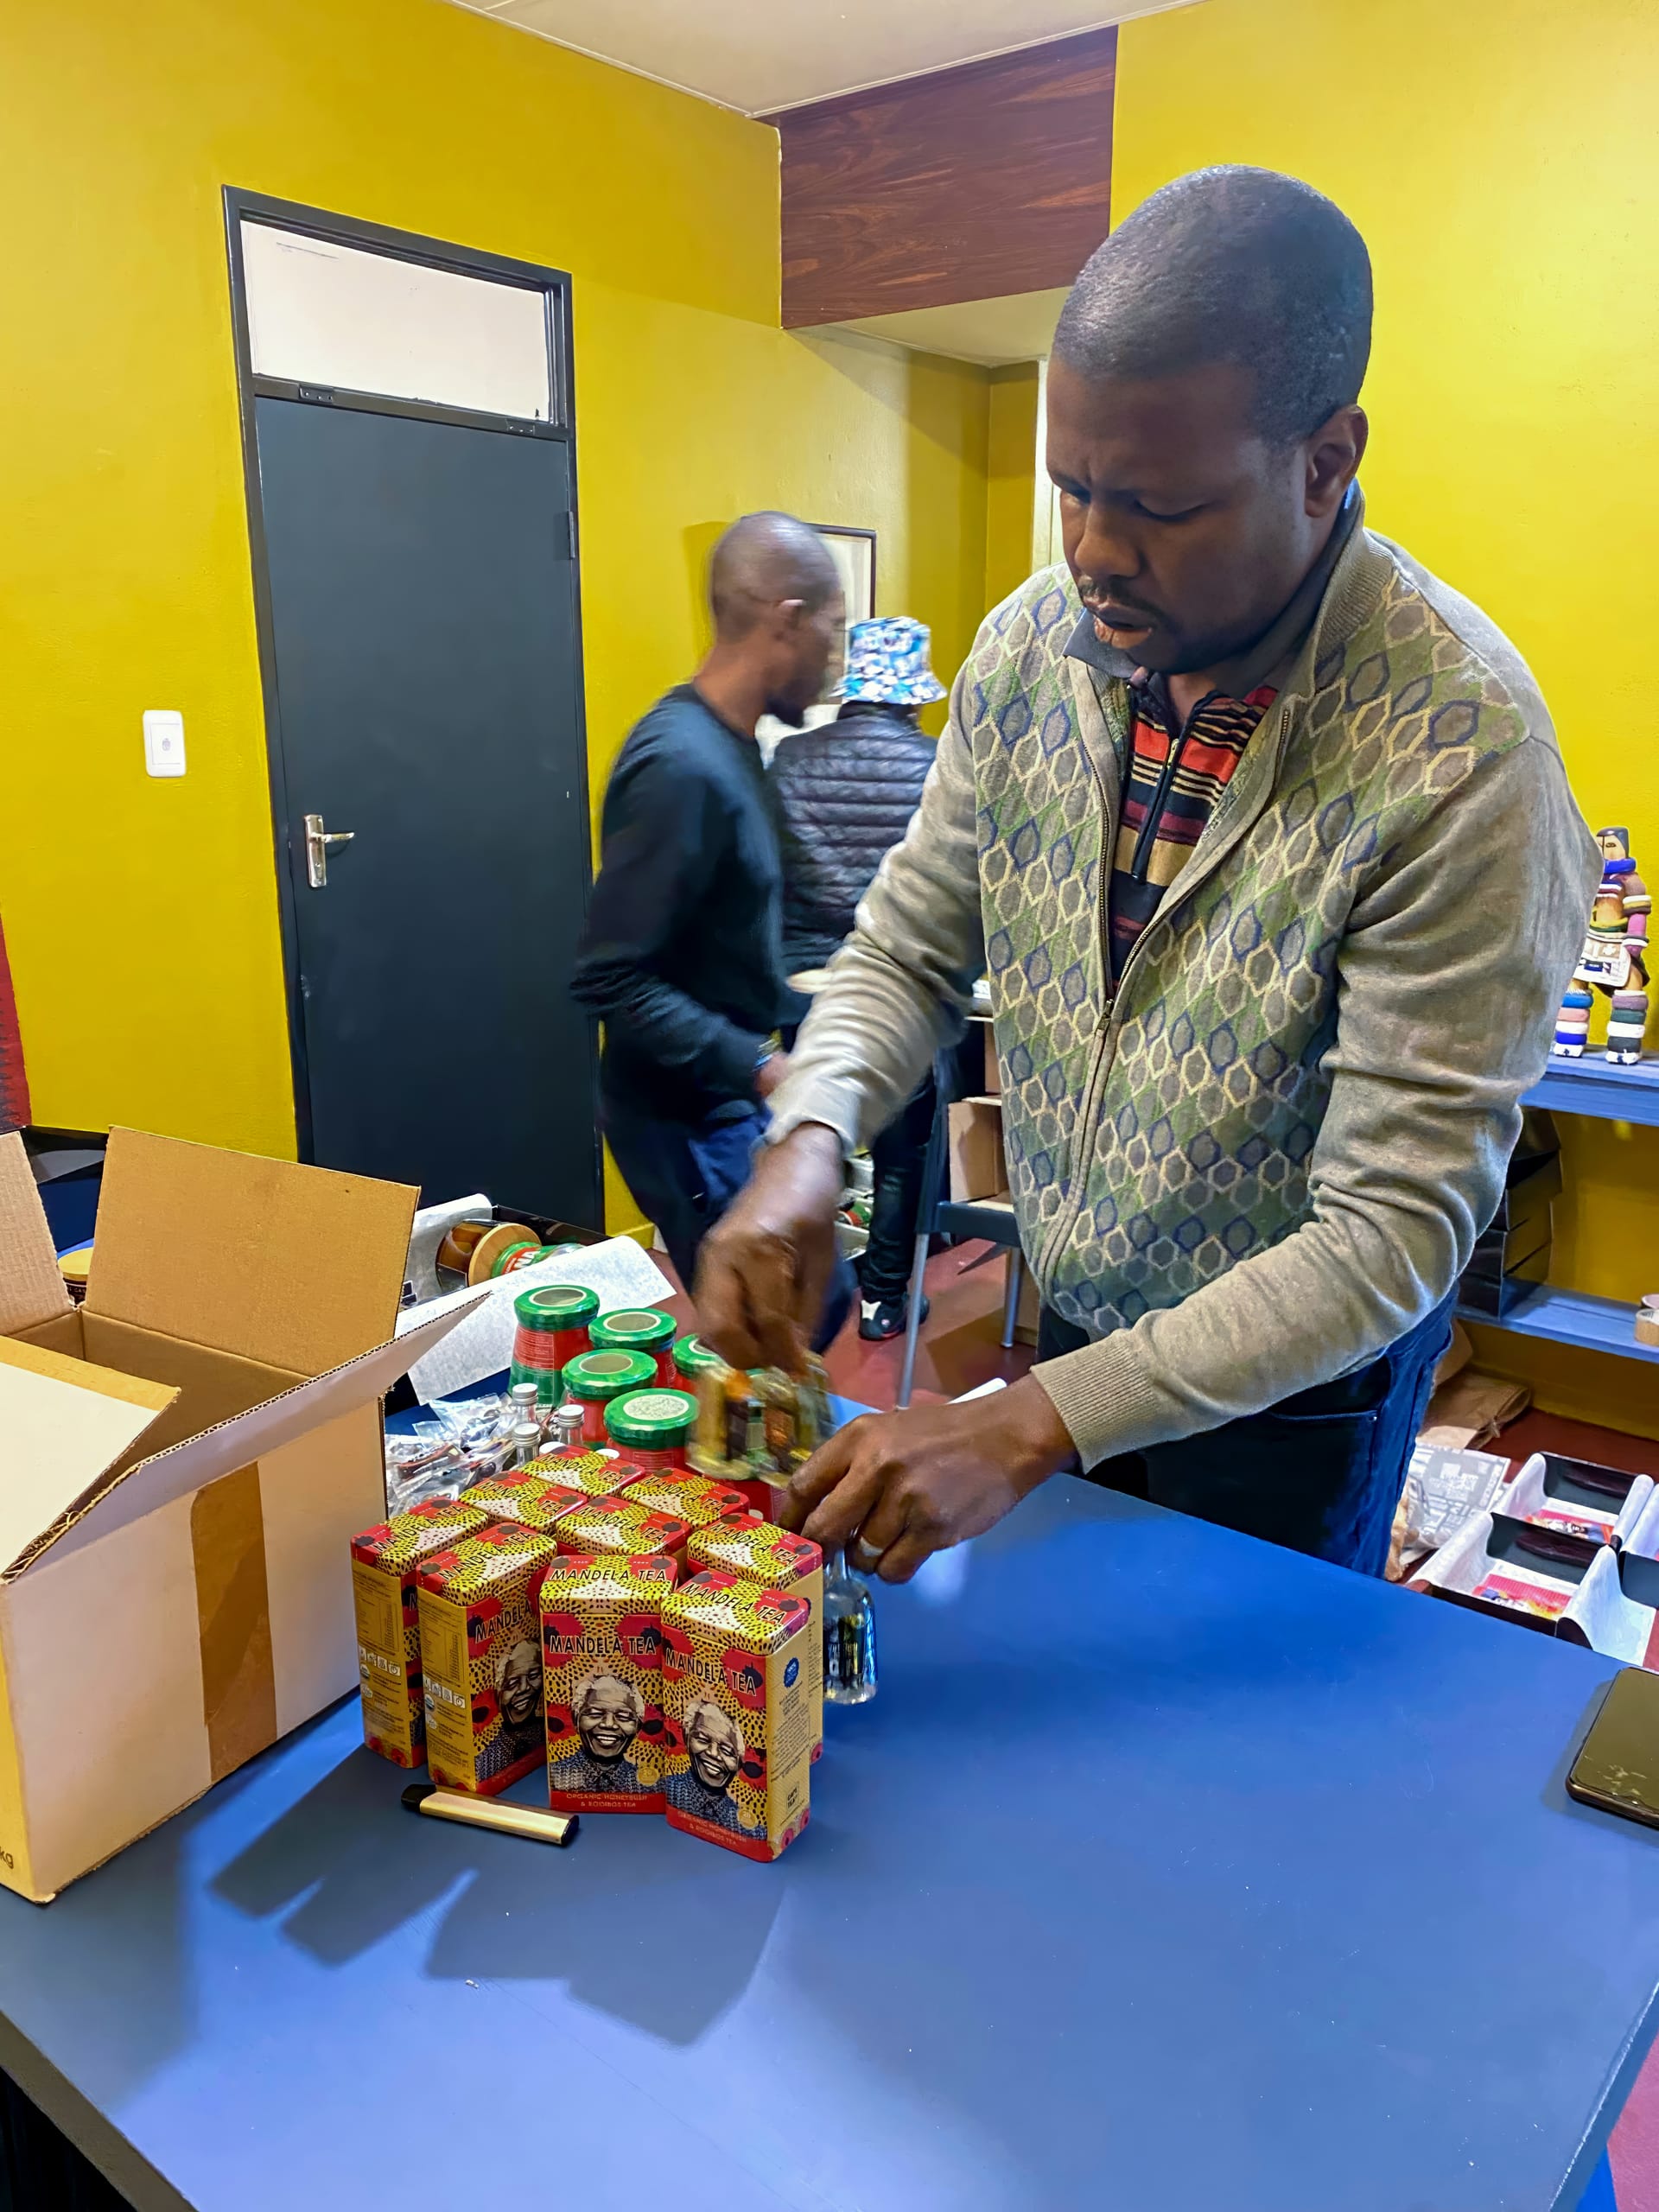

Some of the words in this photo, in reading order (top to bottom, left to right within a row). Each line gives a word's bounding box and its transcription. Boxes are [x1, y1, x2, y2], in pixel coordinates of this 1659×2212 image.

[538, 1453, 598, 1477] MANDELA
[600, 1471, 625, 1484] TEA
[478, 1481, 537, 1506] MANDELA
[540, 1500, 563, 1516] TEA
[645, 1476, 701, 1503] MANDELA
[701, 1497, 728, 1514] TEA
[372, 1518, 437, 1553] MANDELA
[435, 1504, 467, 1519] TEA
[580, 1506, 638, 1533] MANDELA
[639, 1525, 669, 1543] TEA
[710, 1522, 772, 1554] MANDELA
[772, 1547, 799, 1567] TEA
[438, 1545, 505, 1580] MANDELA
[503, 1531, 532, 1547] TEA
[551, 1568, 629, 1582] MANDELA
[639, 1568, 668, 1582] TEA
[475, 1599, 532, 1644] MANDELA
[680, 1582, 753, 1614] MANDELA
[755, 1605, 787, 1625] TEA
[549, 1635, 622, 1656] MANDELA
[628, 1637, 657, 1656] TEA
[664, 1645, 727, 1685] MANDELA
[732, 1670, 757, 1697] TEA
